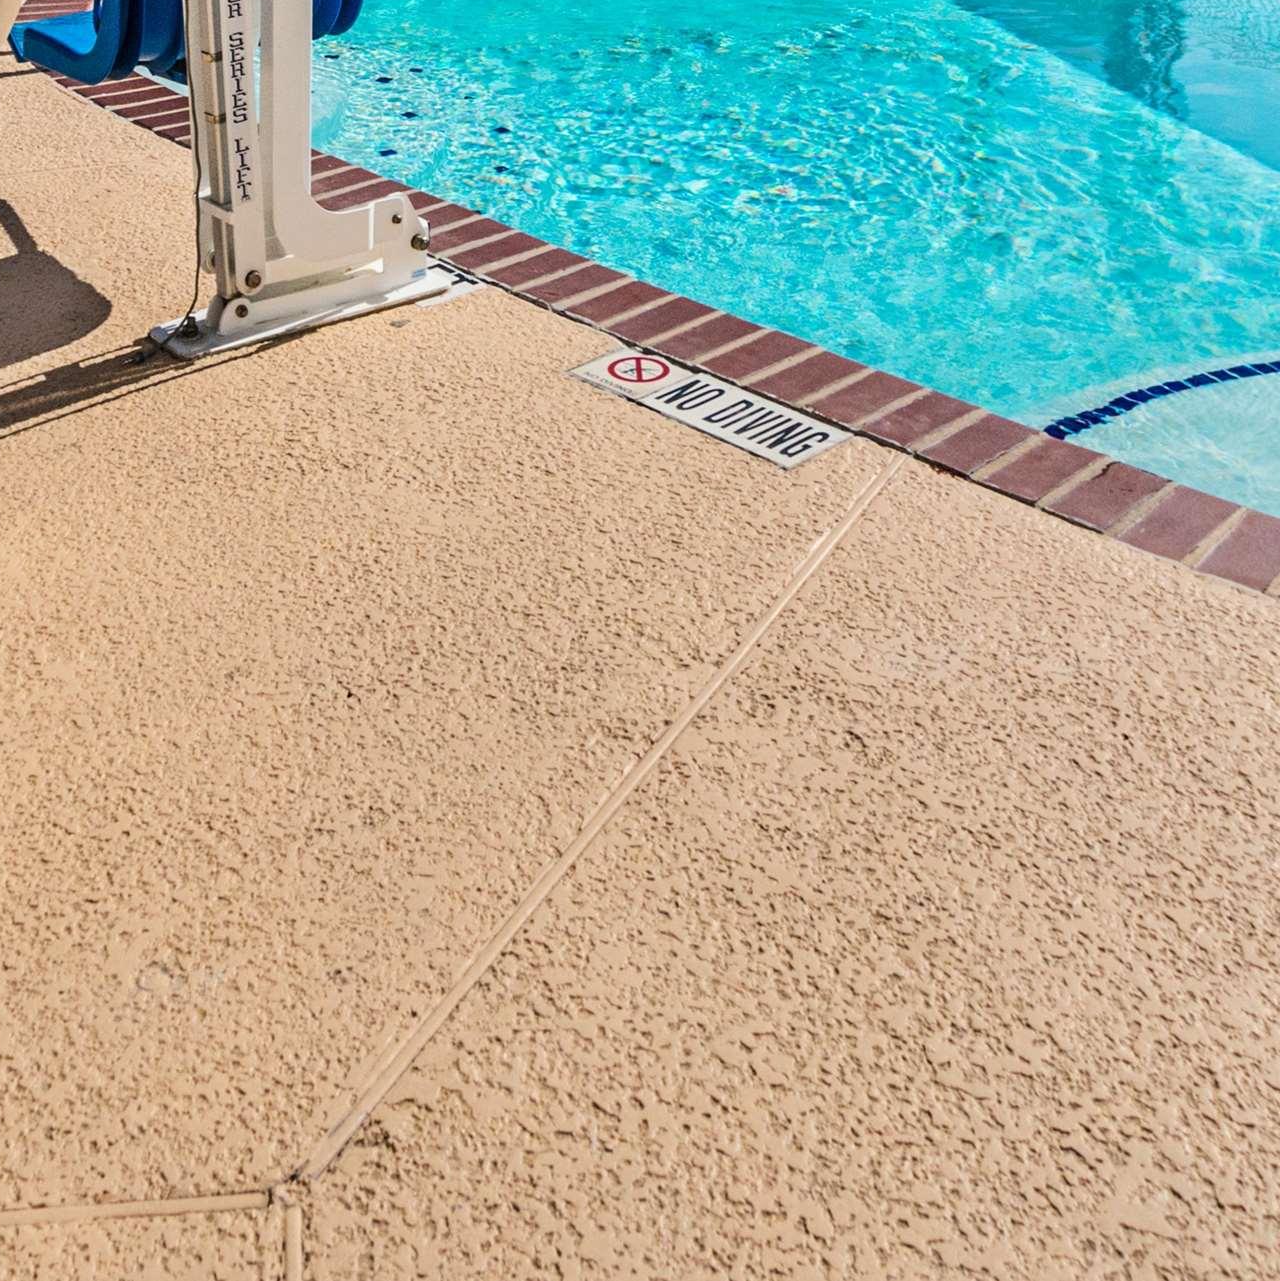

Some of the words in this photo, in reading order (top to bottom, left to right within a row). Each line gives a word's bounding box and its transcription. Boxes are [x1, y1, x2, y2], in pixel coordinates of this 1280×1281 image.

[228, 31, 249, 124] SERIES
[234, 137, 252, 200] LIFT
[654, 379, 726, 411] NO
[701, 399, 830, 458] DIVING
